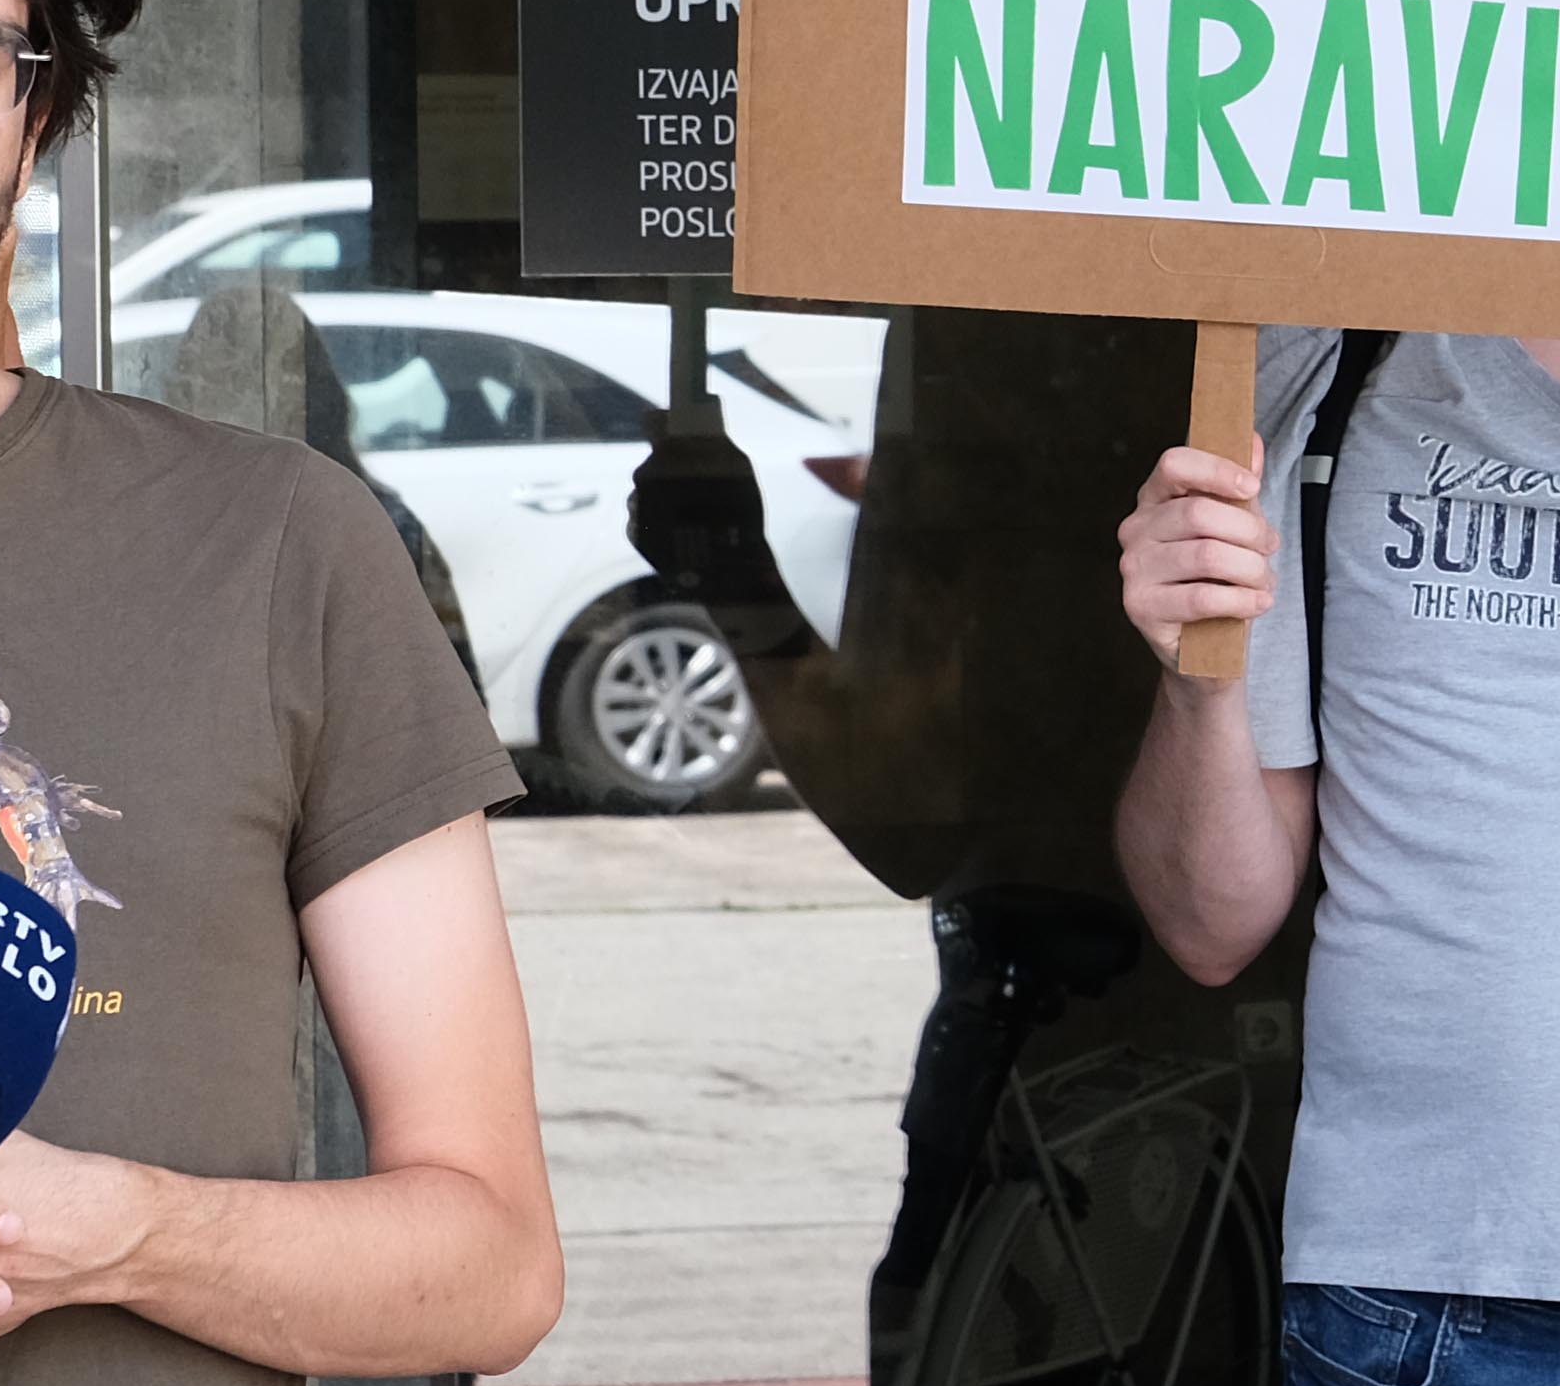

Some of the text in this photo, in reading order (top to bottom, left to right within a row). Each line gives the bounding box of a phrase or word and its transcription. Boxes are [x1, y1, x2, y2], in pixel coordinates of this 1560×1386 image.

[638, 68, 738, 106] IZVAJA
[637, 115, 702, 145] TER
[1412, 583, 1459, 619] THE
